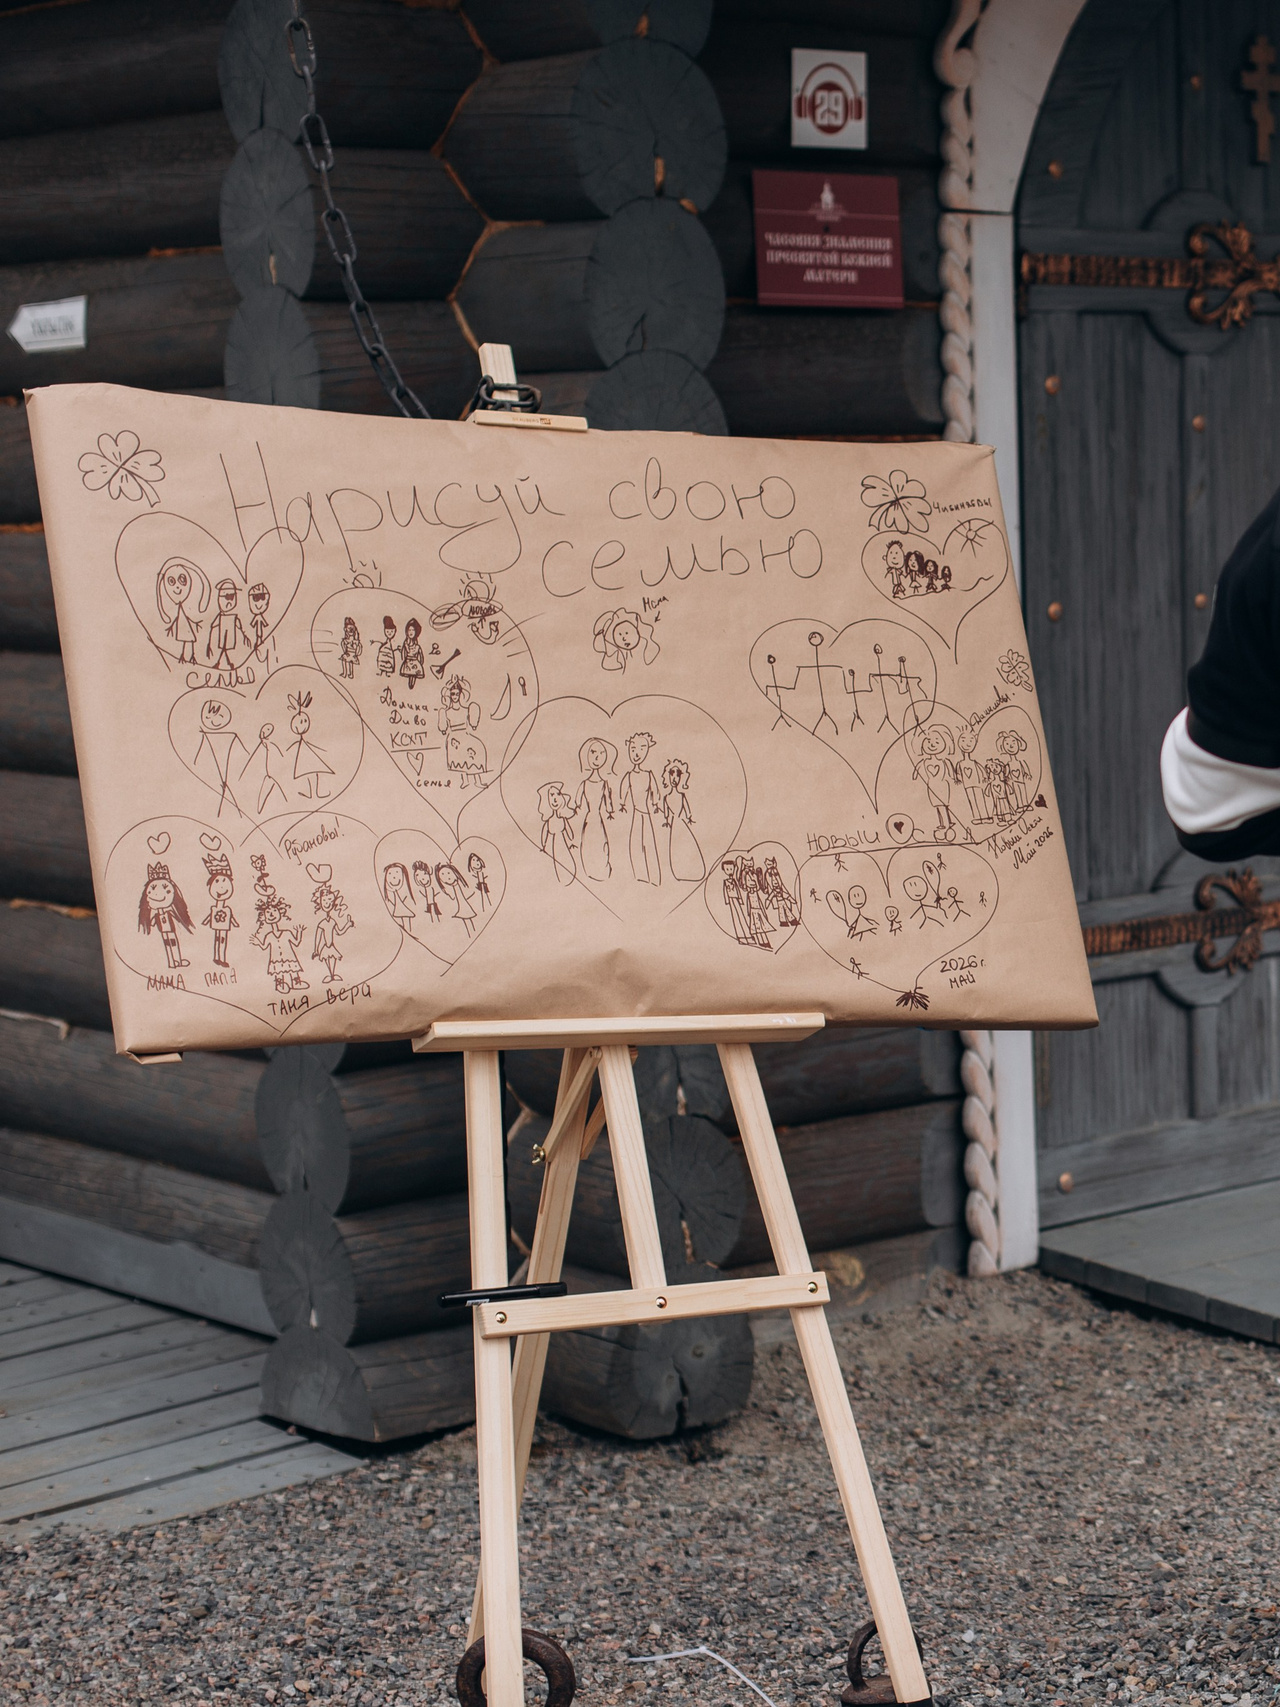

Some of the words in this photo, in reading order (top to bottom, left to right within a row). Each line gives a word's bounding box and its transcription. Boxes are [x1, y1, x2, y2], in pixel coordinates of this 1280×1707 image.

[815, 89, 844, 126] 29
[219, 441, 565, 574] Нарисуй
[609, 456, 796, 520] свою
[541, 528, 823, 598] семью
[146, 973, 186, 992] МАМА
[267, 995, 310, 1016] ТАНЯ
